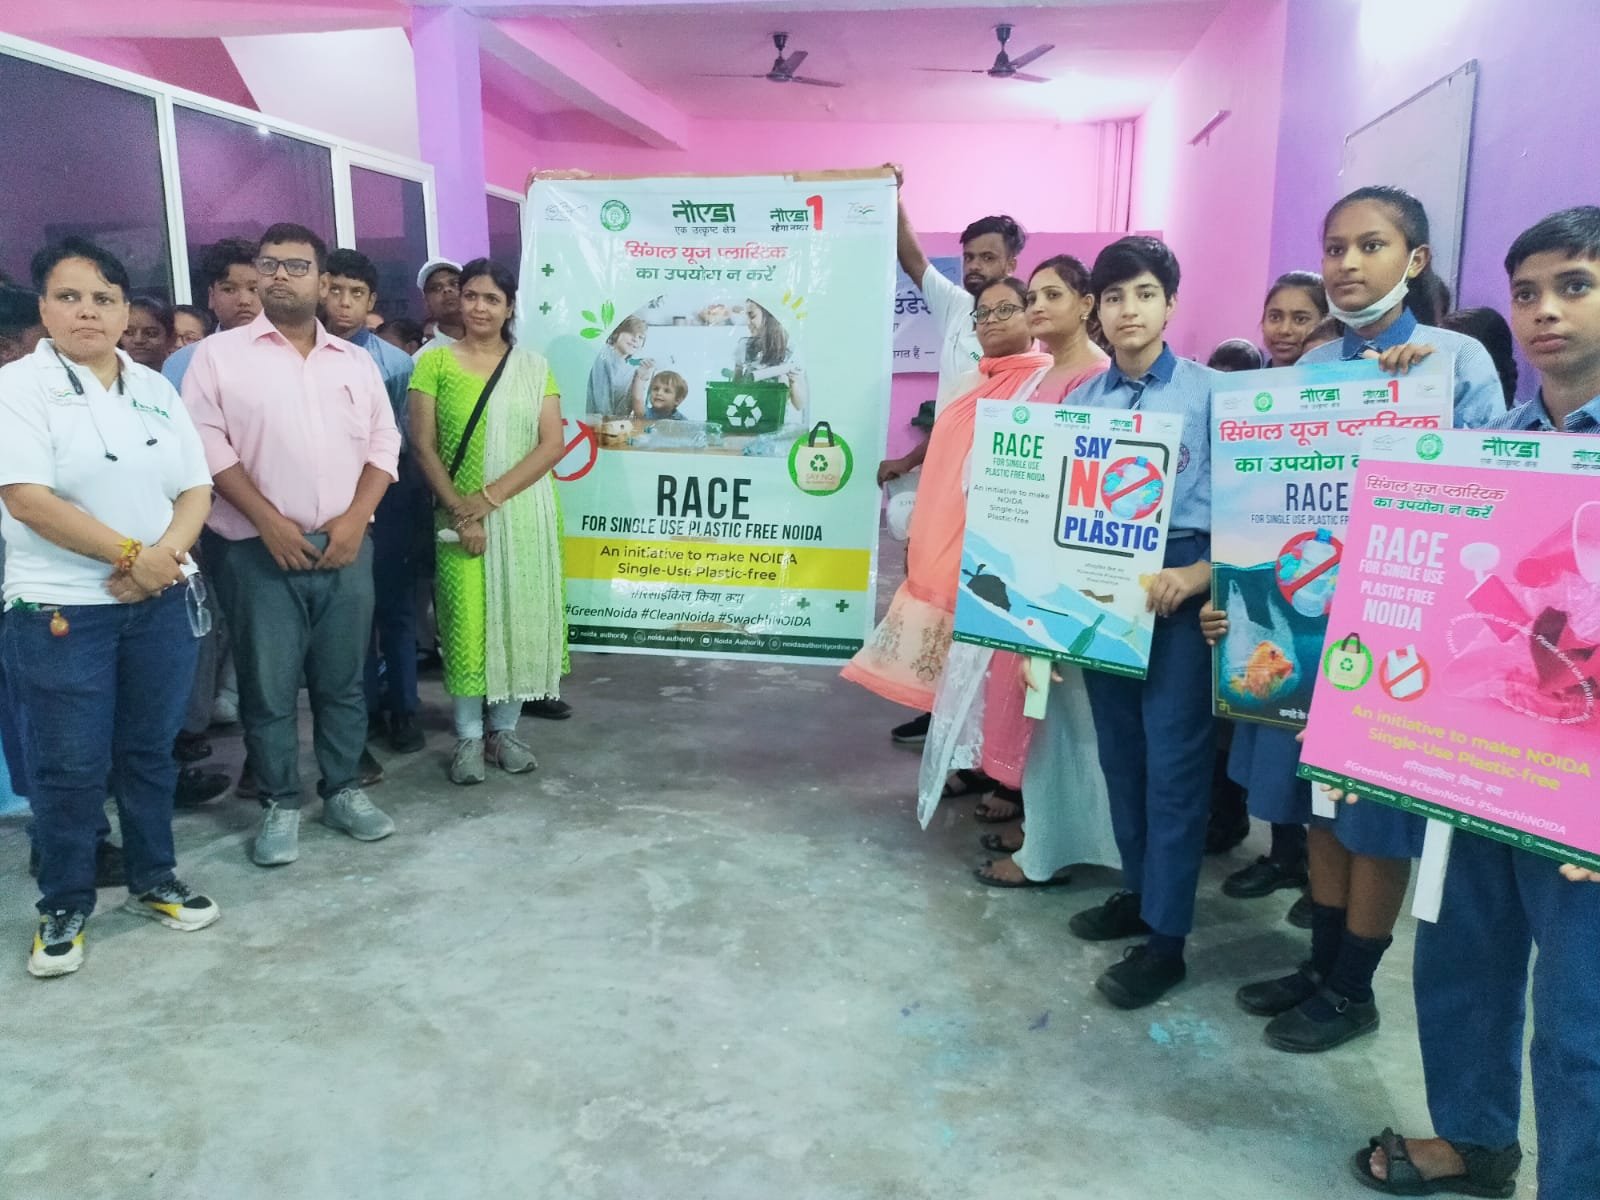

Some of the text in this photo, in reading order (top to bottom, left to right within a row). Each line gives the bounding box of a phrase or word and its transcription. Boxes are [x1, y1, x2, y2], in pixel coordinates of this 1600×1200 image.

[806, 195, 823, 231] 1
[624, 240, 789, 264] सिंगल यूज प्लास्टिक
[635, 265, 777, 281] का उपयोग न करें
[1388, 380, 1398, 403] 1
[1132, 413, 1142, 433] 1
[1219, 420, 1284, 442] सिंगल
[1289, 421, 1329, 446] यूज
[993, 431, 1045, 459] RACE
[1074, 435, 1113, 459] SAY
[985, 467, 1009, 478] PLASTIC
[1010, 470, 1026, 480] FREE
[1235, 457, 1262, 473] का
[1269, 450, 1345, 472] उपयोग
[657, 475, 752, 520] RACE
[1286, 482, 1348, 512] RACE
[1367, 476, 1506, 500] सिंगल यूज प्लास्टिक
[1095, 509, 1104, 519] TO
[1251, 514, 1264, 524] FOR
[1292, 514, 1307, 525] USE
[1308, 515, 1338, 525] PLASTIC
[1374, 497, 1494, 519] का उपयोग न करें
[582, 515, 822, 541] FOR SINGLE USE PLASTIC FREE NOIDA
[1064, 516, 1159, 552] PLASTIC
[600, 545, 797, 565] An initiative to make NOIDA
[1365, 524, 1449, 569] RACE
[618, 563, 776, 580] Single-Use Plastic-free
[1359, 559, 1446, 585] FOR SINGLE USE
[1360, 580, 1436, 606] PLASTIC FREE
[565, 605, 637, 619] #GreenNoida
[641, 609, 715, 623] #CleanNoida
[1362, 598, 1422, 632] NOIDA
[1352, 704, 1372, 719] An
[1450, 730, 1467, 744] to
[1471, 737, 1521, 758] make
[1527, 748, 1591, 778] NOIDA
